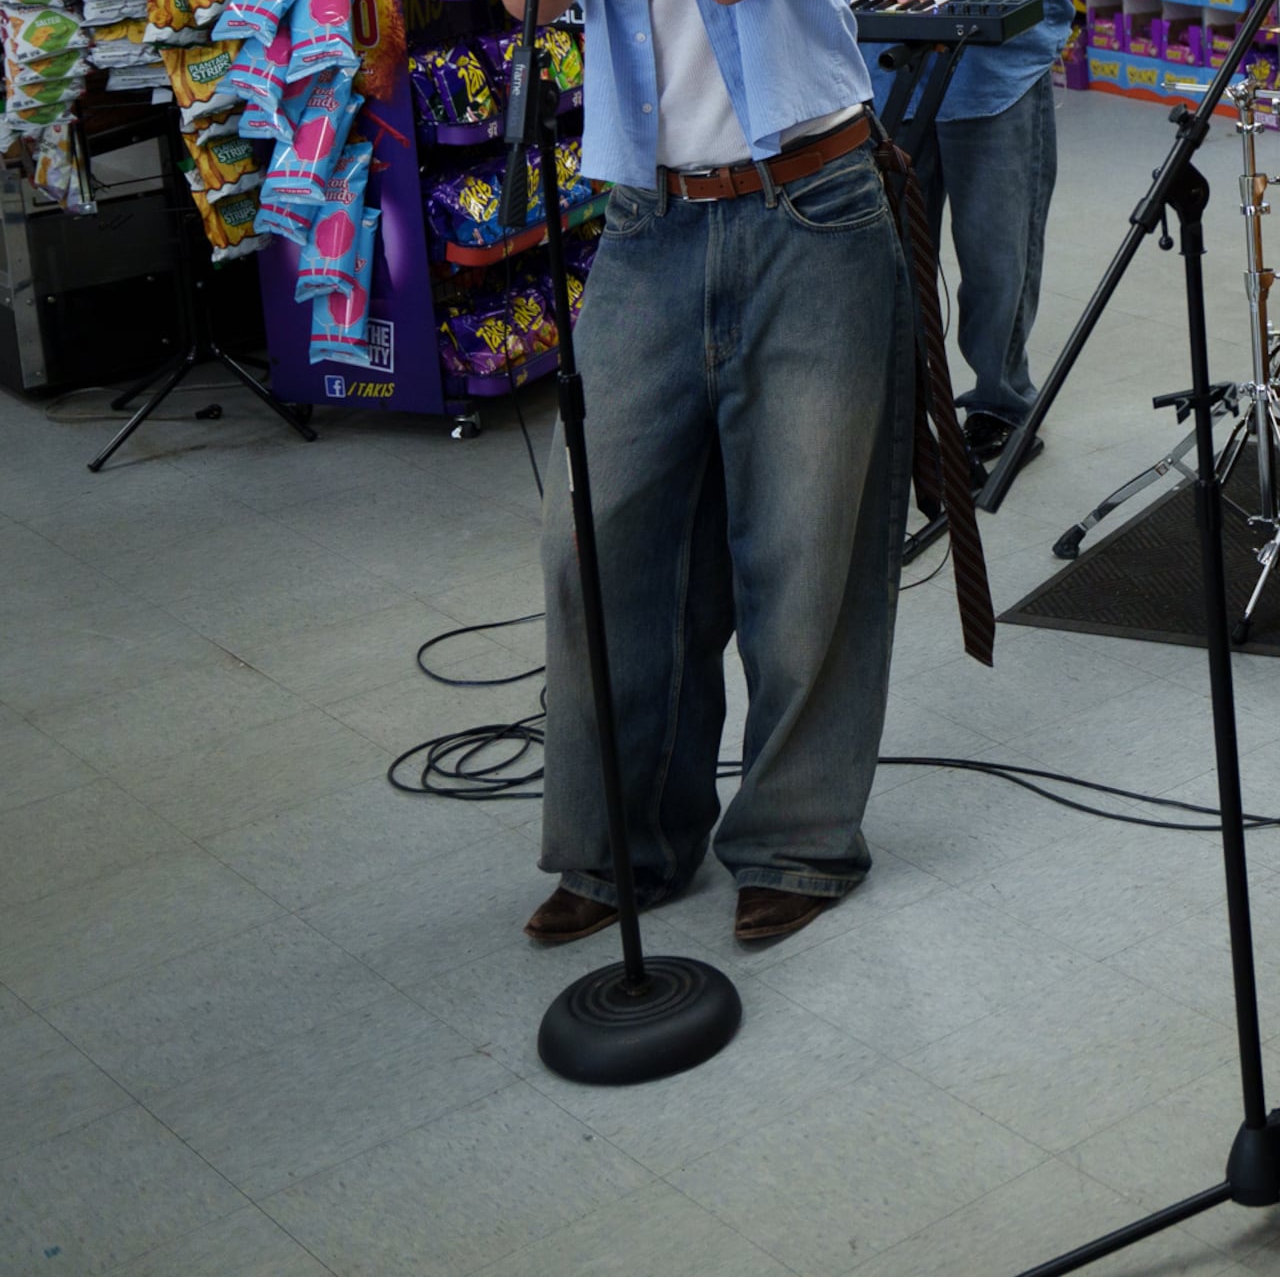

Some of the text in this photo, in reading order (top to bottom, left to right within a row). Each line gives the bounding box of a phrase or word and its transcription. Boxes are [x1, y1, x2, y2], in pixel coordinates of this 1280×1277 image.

[189, 54, 231, 72] PLANTAIN
[191, 62, 233, 82] STRIPS
[308, 97, 341, 112] ndy
